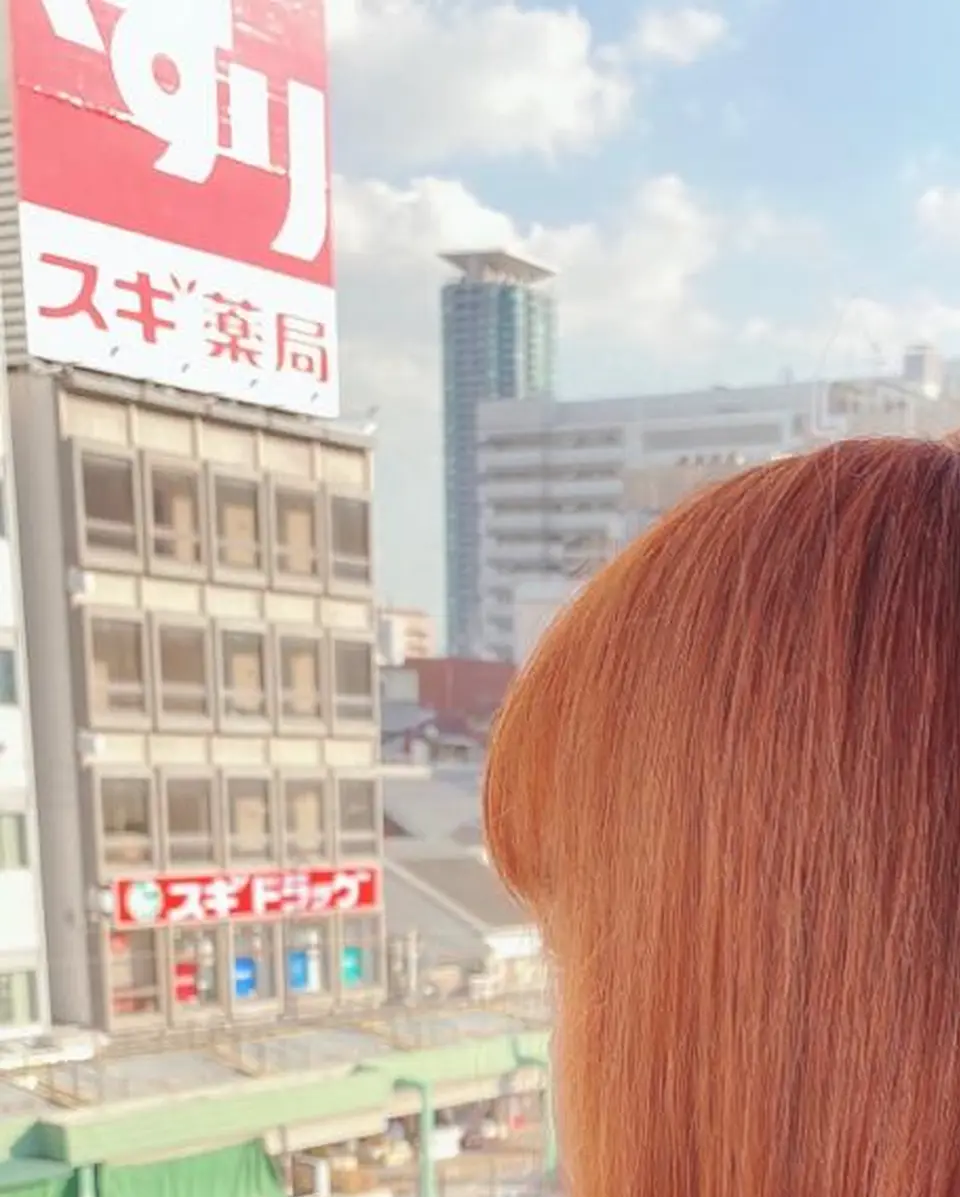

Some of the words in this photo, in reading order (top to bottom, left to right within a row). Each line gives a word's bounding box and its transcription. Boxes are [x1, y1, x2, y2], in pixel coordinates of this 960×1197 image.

[42, 0, 328, 262] すり
[38, 252, 329, 383] スギ薬局
